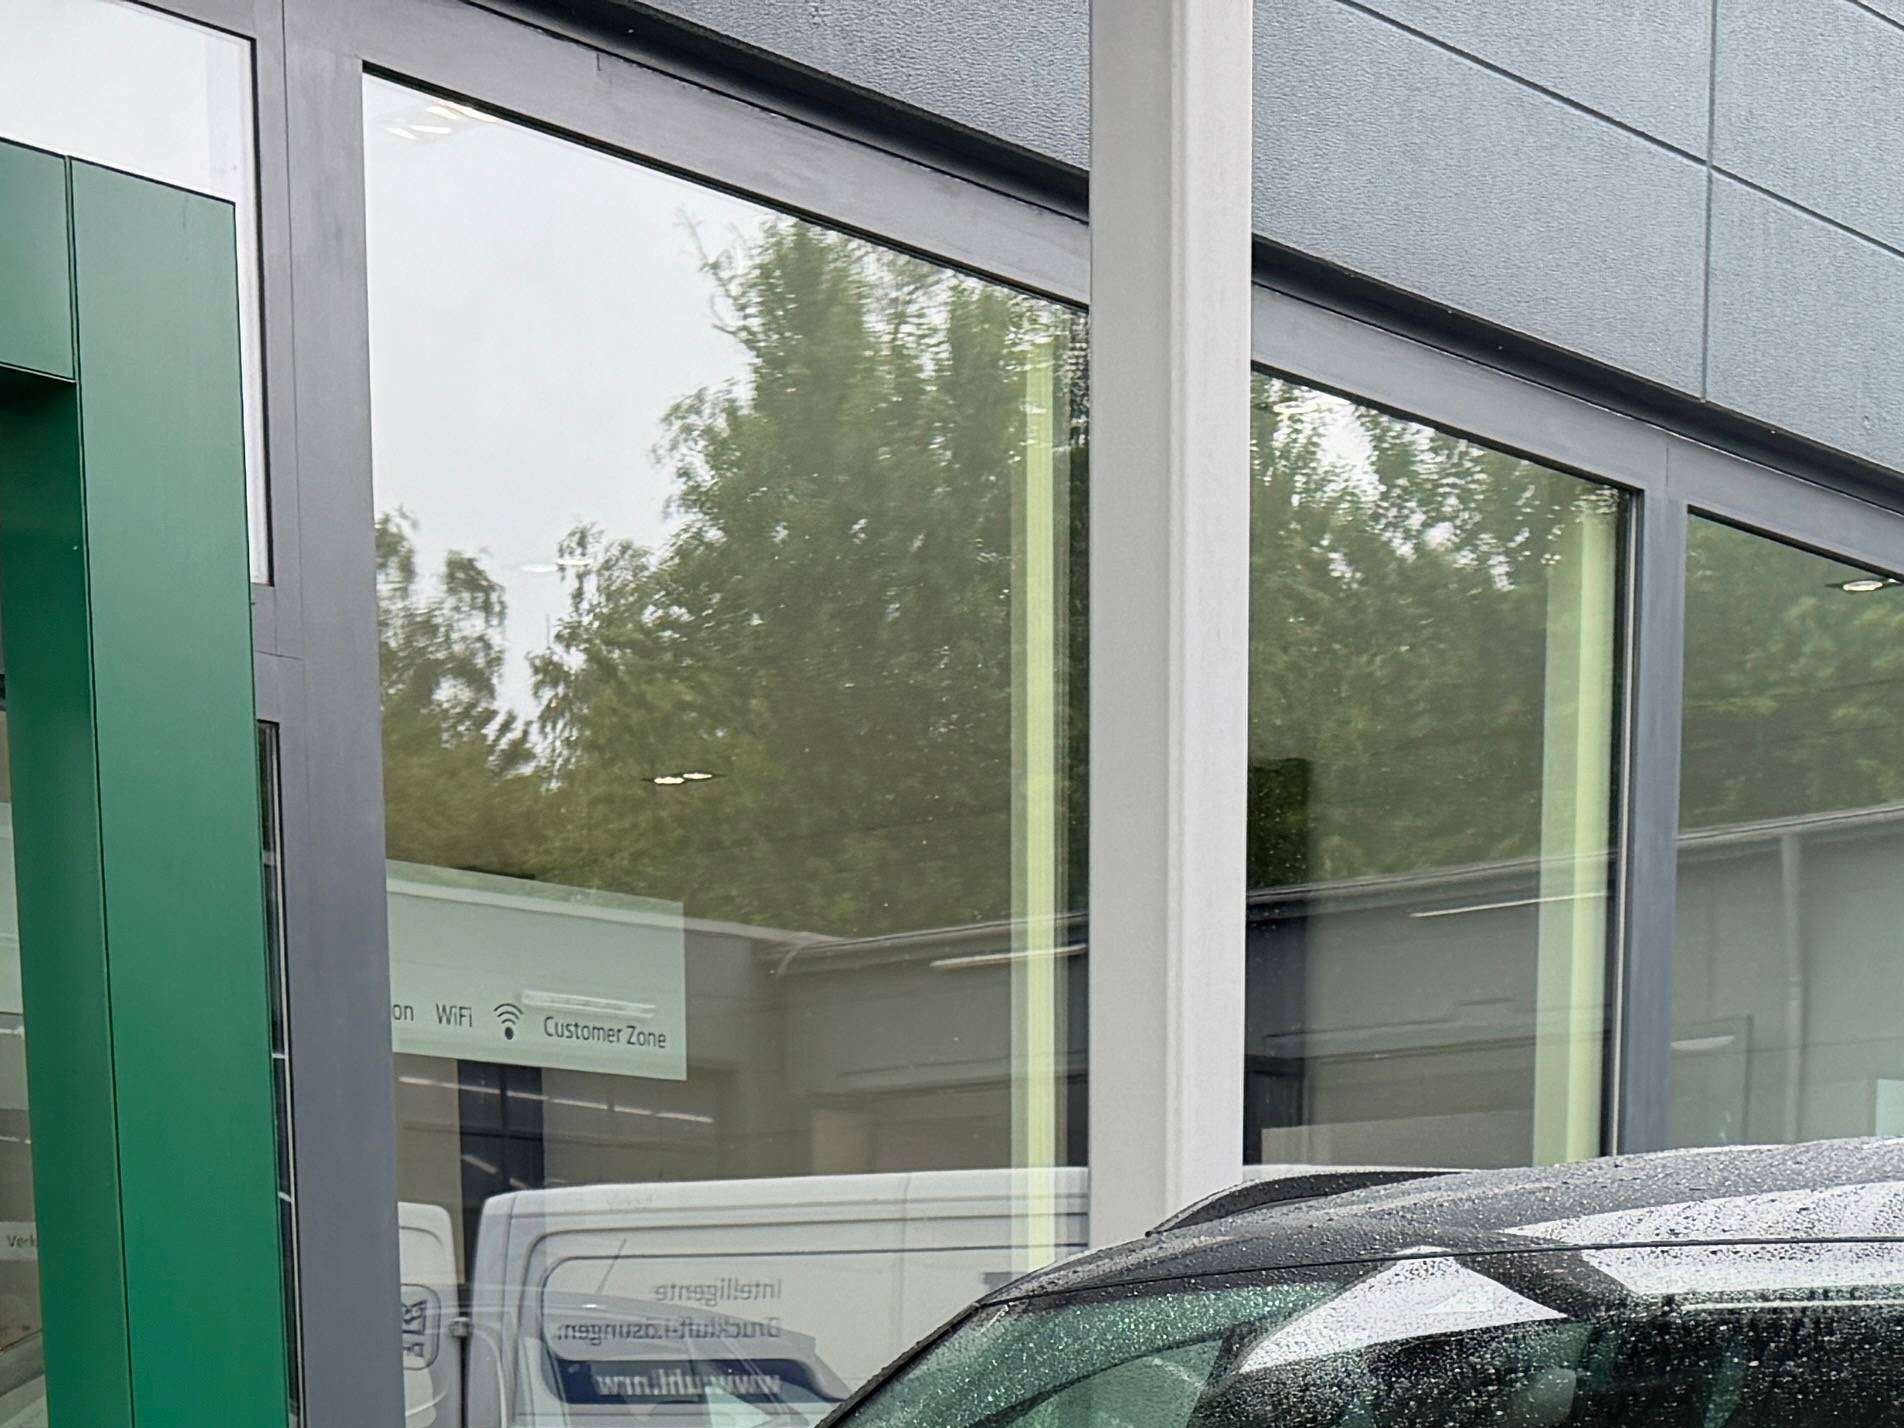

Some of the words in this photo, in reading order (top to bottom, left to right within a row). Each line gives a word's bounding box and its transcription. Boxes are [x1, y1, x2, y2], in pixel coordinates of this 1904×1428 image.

[435, 1002, 474, 1029] WiFi
[542, 1015, 623, 1045] Customer
[626, 1024, 667, 1050] Zone
